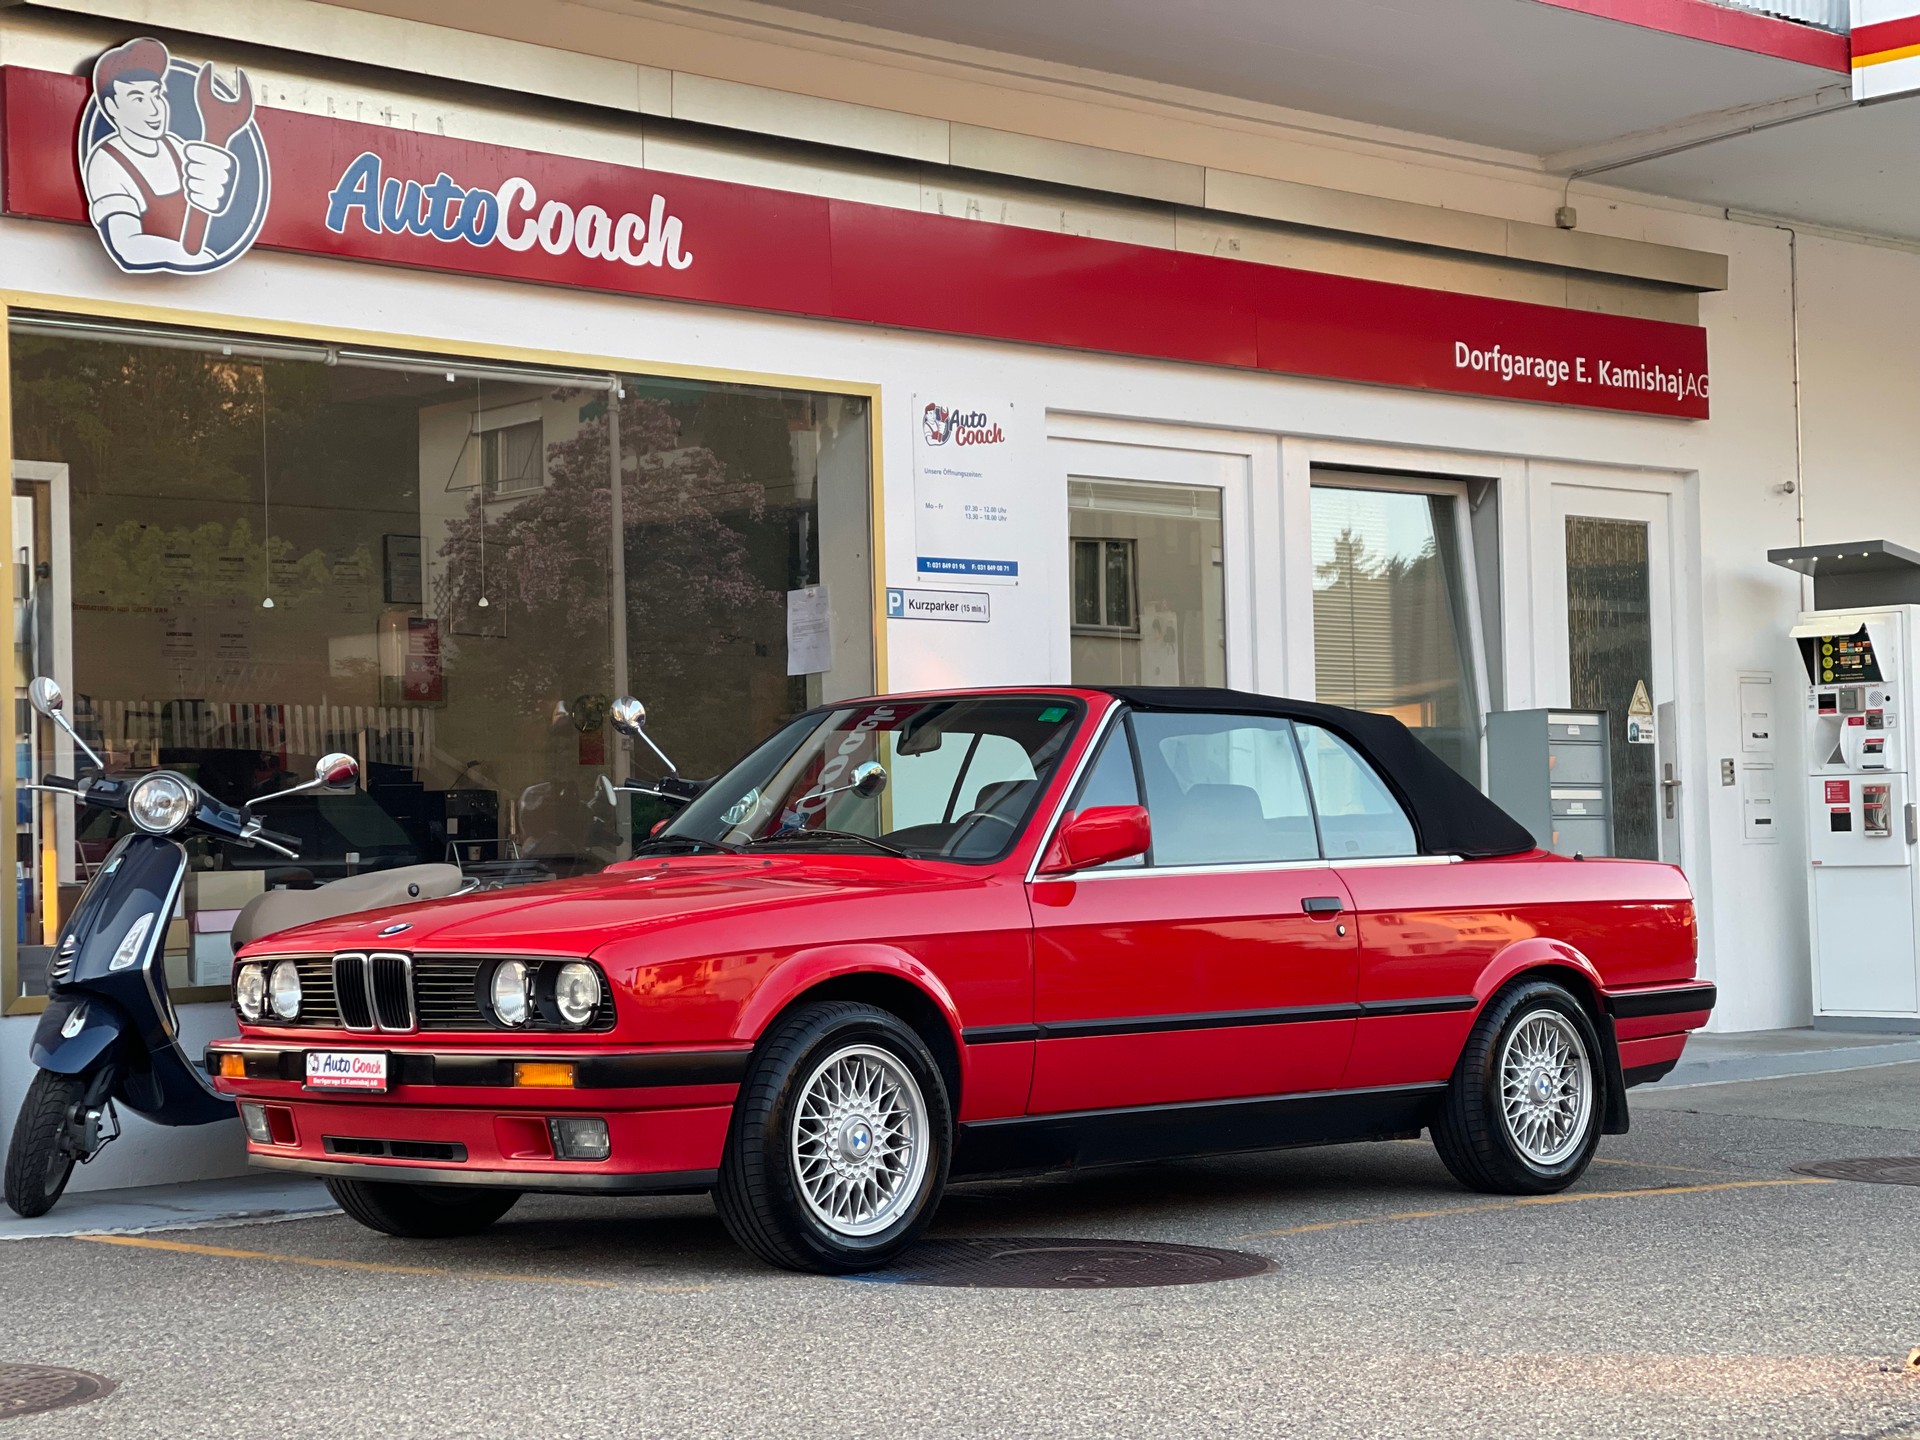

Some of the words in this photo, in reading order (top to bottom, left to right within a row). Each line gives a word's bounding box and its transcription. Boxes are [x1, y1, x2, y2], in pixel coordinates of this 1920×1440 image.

[1455, 341, 1570, 386] Dorfgarage
[1576, 357, 1592, 383] E.
[949, 409, 987, 430] Auto
[955, 423, 1006, 446] Coach
[888, 592, 902, 614] P
[908, 598, 959, 613] Kurzparker
[961, 604, 970, 613] (15
[971, 605, 986, 615] min.)
[323, 1054, 351, 1073] Auto
[352, 1057, 382, 1074] Coach
